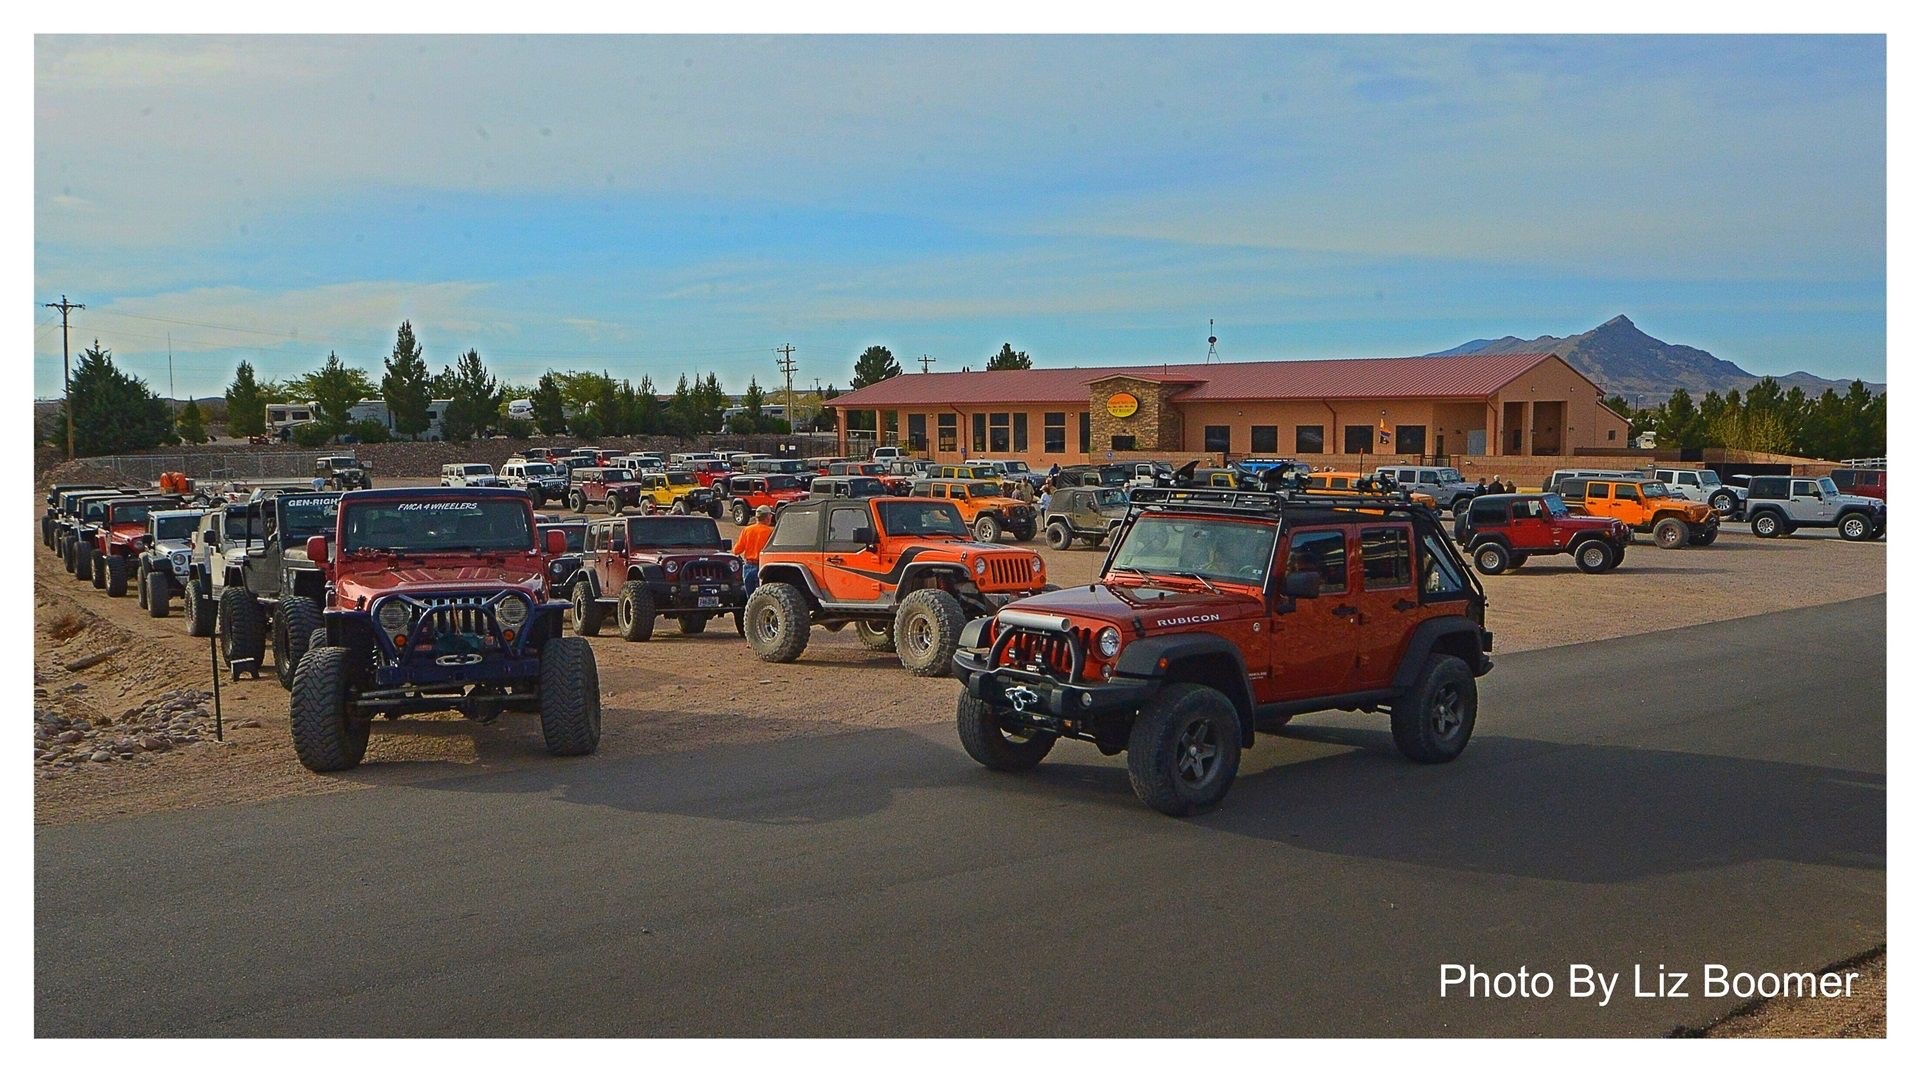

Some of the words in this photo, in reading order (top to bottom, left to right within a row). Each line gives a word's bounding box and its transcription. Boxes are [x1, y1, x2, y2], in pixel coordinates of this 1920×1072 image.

[288, 498, 339, 507] GEN-RIGH
[397, 503, 422, 511] FMCA
[430, 502, 478, 510] WHEELERS
[1157, 614, 1220, 627] RUBICON
